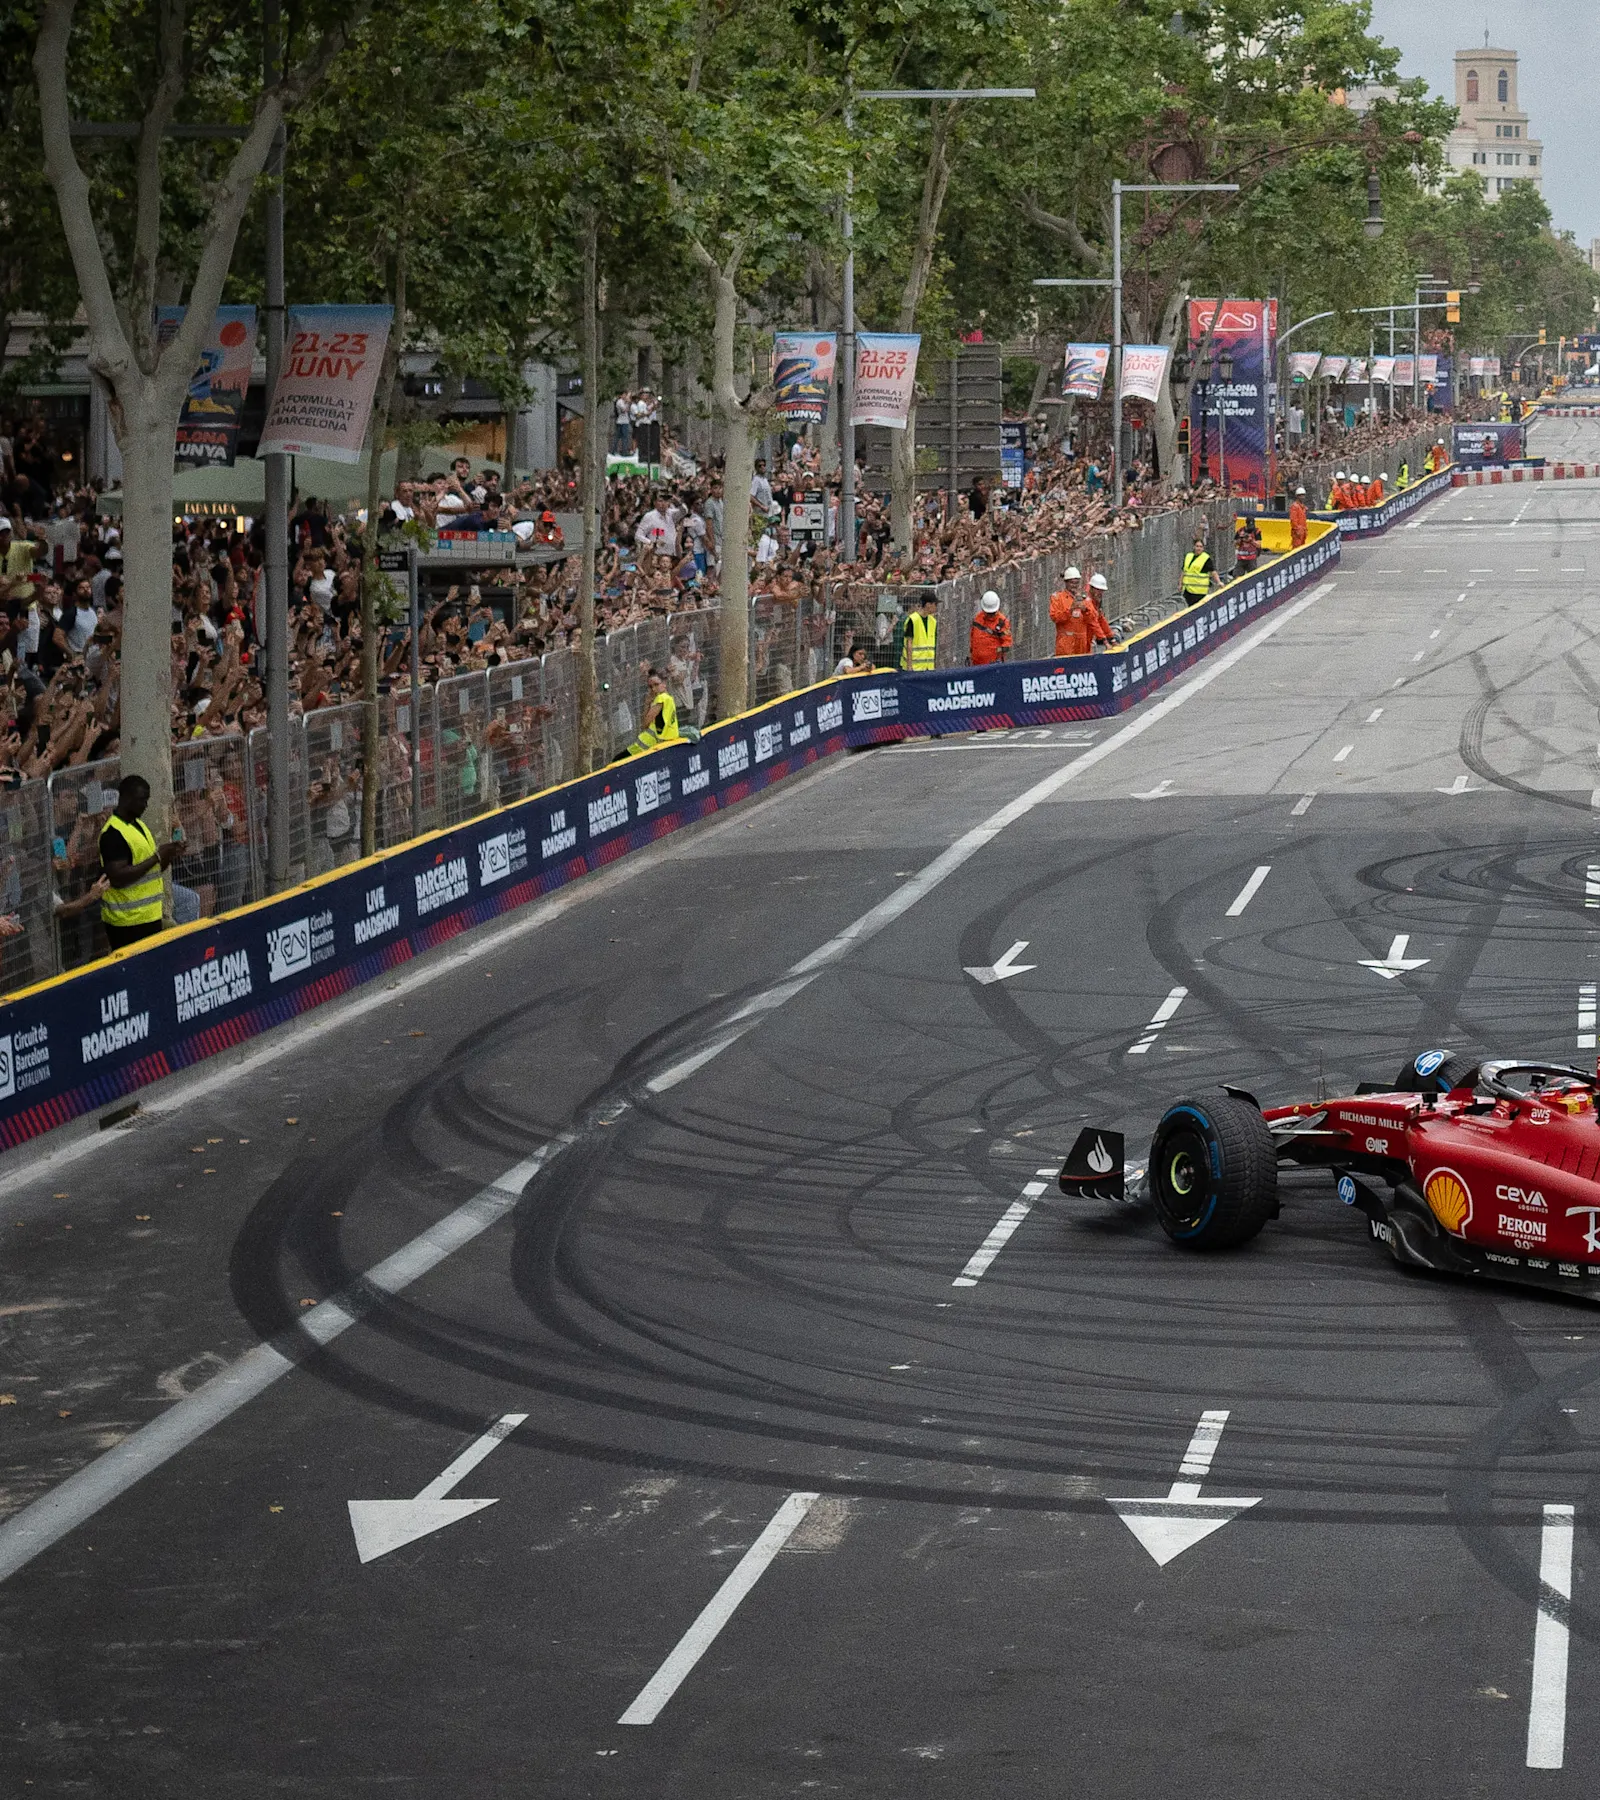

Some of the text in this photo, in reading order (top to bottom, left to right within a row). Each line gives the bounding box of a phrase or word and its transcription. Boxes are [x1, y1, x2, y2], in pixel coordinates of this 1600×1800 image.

[292, 332, 369, 355] 21-23
[283, 356, 366, 381] JUNY
[860, 350, 908, 364] 21-23
[1124, 362, 1160, 371] JUNY
[1126, 354, 1161, 362] 21-23
[859, 365, 906, 380] JUNY
[286, 394, 345, 408] FORMULA
[277, 416, 347, 432] BARCELONA
[299, 406, 355, 420] ARRIBAT
[946, 680, 975, 696] LIVE
[1021, 672, 1098, 694] BARCELONA
[1023, 686, 1099, 703] FAN FESTIVAL 2024
[928, 692, 995, 713] ROADSHOW
[588, 789, 628, 824] BARCELONA
[550, 809, 565, 833] LIVE
[541, 827, 577, 859] ROADSHOW
[415, 857, 468, 900] BARCELONA
[366, 886, 385, 914] LIVE
[354, 905, 400, 945] ROADSHOW
[174, 949, 250, 1004] BARCELONA
[100, 989, 129, 1024] LIVE
[177, 976, 252, 1024] FAN FESTIVAL 2024
[14, 1022, 48, 1052] Circuit de
[81, 1011, 150, 1064] ROADSHOW
[15, 1046, 49, 1071] Barcelona
[16, 1067, 51, 1091] CATALUNYA
[1339, 1111, 1404, 1131] RICHARD MILLE
[1531, 1107, 1552, 1120] aws
[1339, 1177, 1355, 1204] hp
[1518, 1204, 1549, 1214] LOGISTICS
[1371, 1220, 1392, 1244] VGW
[1519, 1233, 1547, 1243] AZZURRO
[1559, 1263, 1579, 1274] NGK
